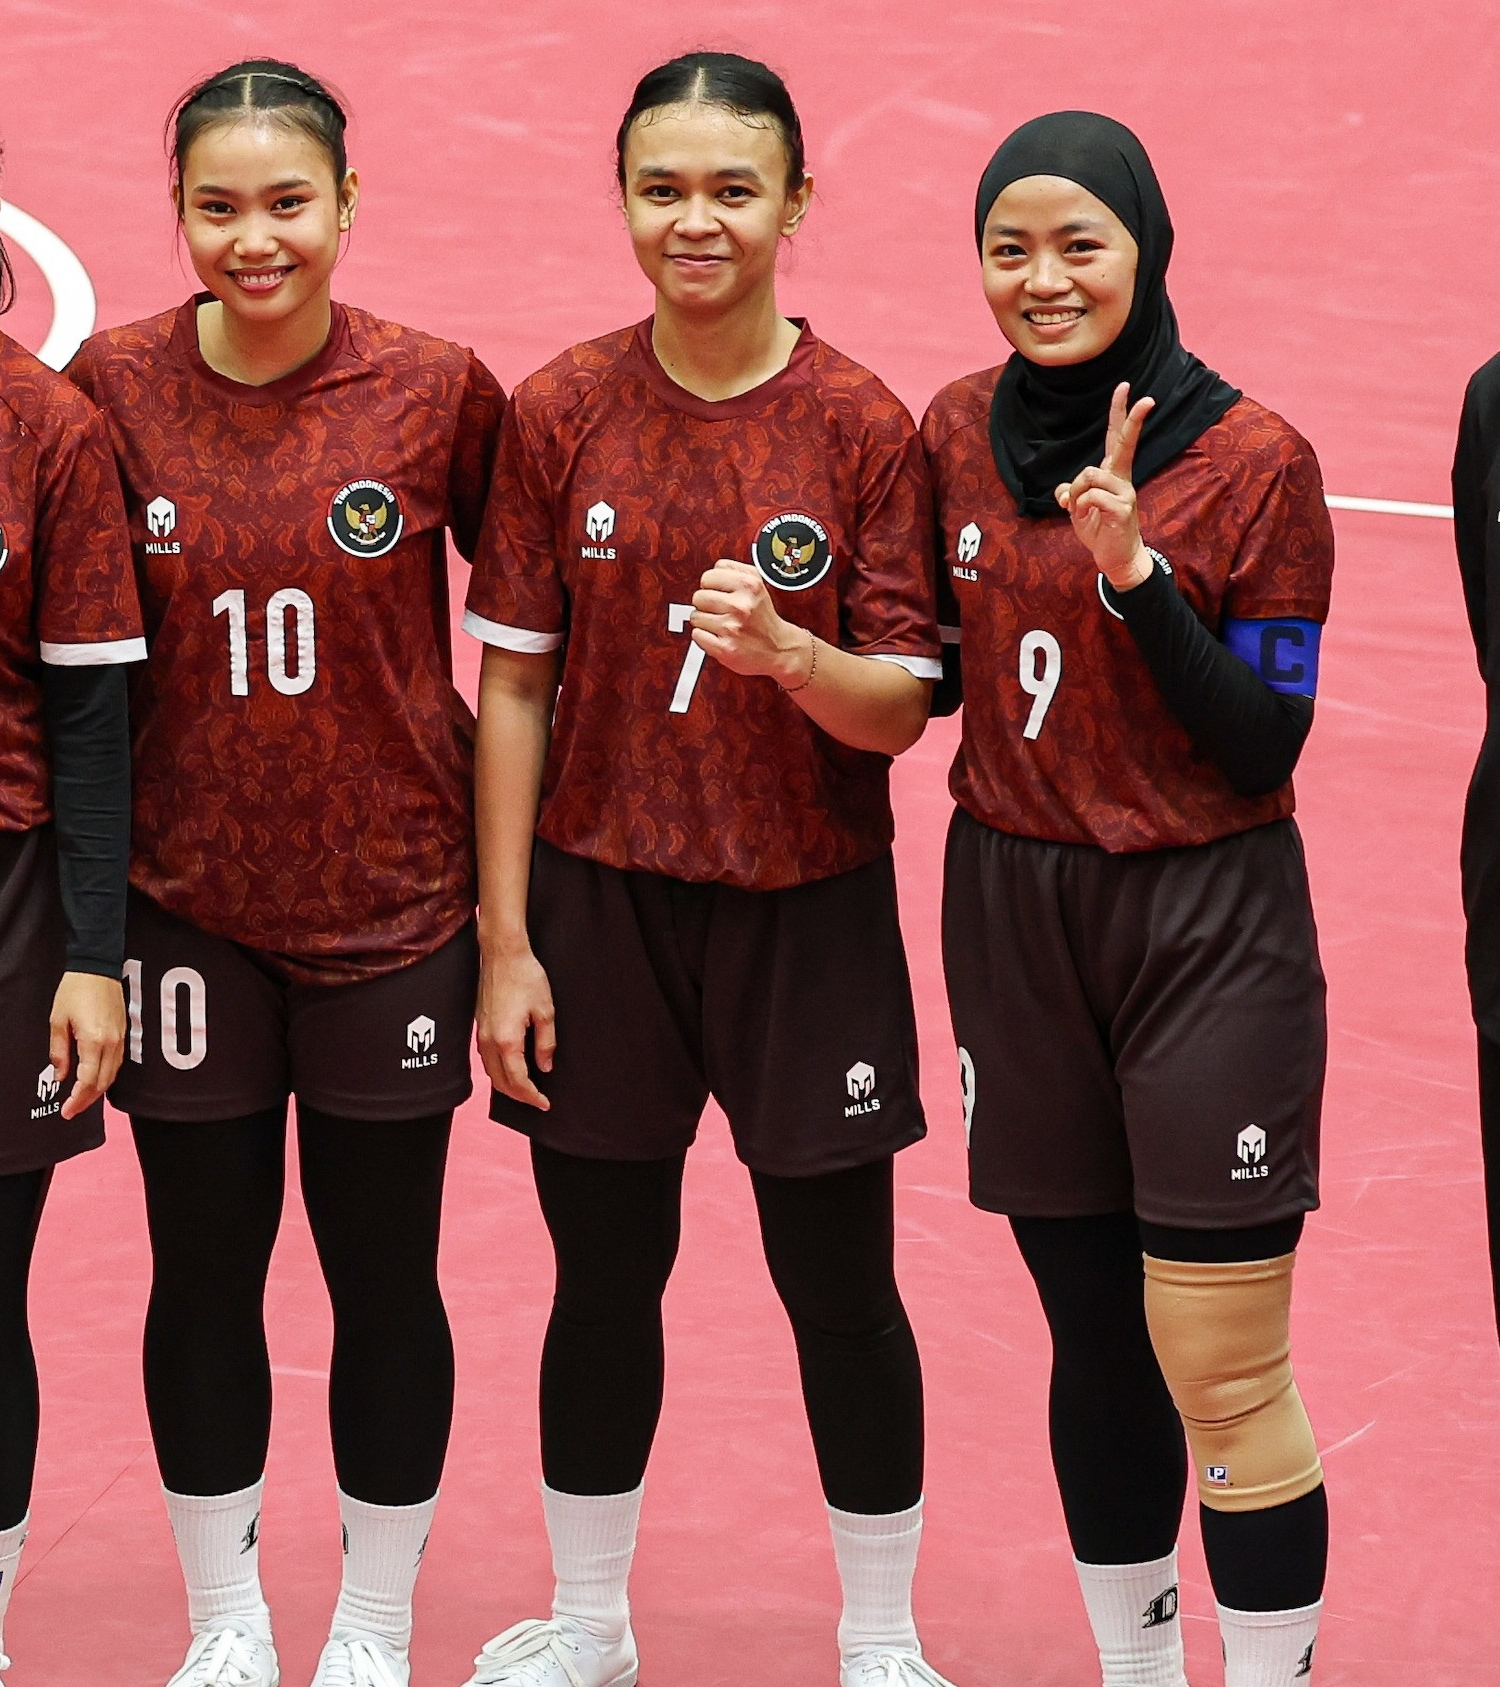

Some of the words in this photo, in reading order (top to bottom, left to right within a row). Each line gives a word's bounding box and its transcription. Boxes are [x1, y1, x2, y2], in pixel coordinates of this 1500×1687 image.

[333, 487, 351, 505] TIM
[347, 479, 395, 503] INDONESIA
[761, 517, 781, 534] TIM
[779, 513, 827, 542] INDONESIA
[145, 541, 181, 554] MILLS
[581, 546, 616, 560] MILLS
[1145, 546, 1173, 575] ONESIA
[952, 565, 978, 581] MILLS
[212, 587, 316, 696] 10
[668, 603, 706, 714] 7
[1260, 626, 1305, 684] C
[1019, 629, 1062, 740] 9
[122, 958, 207, 1070] 10
[401, 1053, 438, 1070] MILLS
[31, 1101, 60, 1120] MILLS
[844, 1098, 881, 1118] MILLS
[1231, 1165, 1269, 1181] MILLS
[1207, 1467, 1225, 1480] LP
